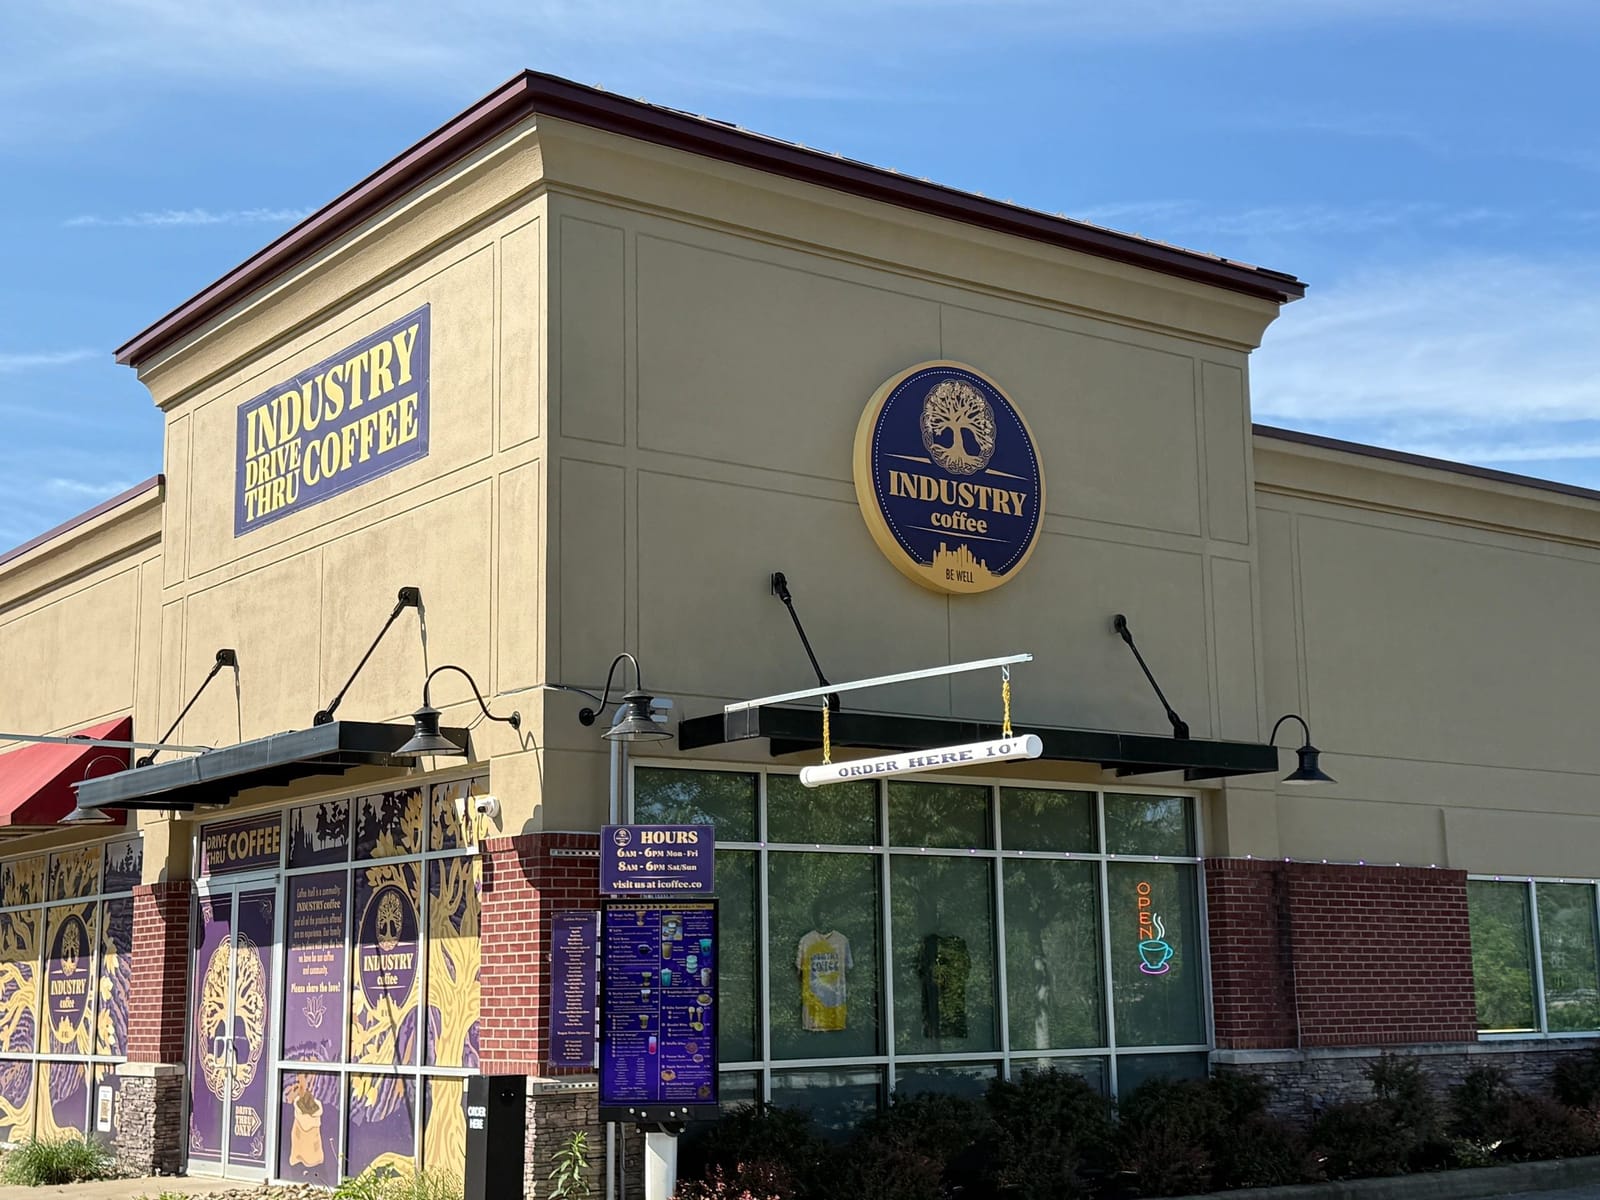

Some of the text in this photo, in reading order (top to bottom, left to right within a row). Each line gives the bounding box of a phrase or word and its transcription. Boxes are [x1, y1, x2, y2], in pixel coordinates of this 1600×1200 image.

[246, 323, 419, 461] INDUSTRY
[302, 392, 418, 486] COFFEE
[245, 437, 302, 491] DRIVE
[244, 468, 300, 522] THRU
[888, 469, 1027, 517] INDUSTRY
[930, 510, 988, 534] coffee
[945, 568, 975, 583] BE WELL
[838, 760, 899, 777] ORDER
[908, 750, 974, 769] HERE
[206, 834, 227, 850] DRIVE
[227, 825, 280, 861] COFFEE
[640, 831, 698, 845] HOURS
[207, 849, 226, 865] THRU
[617, 847, 637, 858] 6AM
[644, 847, 664, 858] 6PM
[617, 861, 638, 872] 8AM
[645, 861, 665, 872] 6PM
[612, 879, 702, 889] visit us at icoffee.co
[296, 898, 341, 912] INDUSTRY coffee
[1136, 881, 1154, 940] OPEN
[363, 953, 414, 972] INDUSTRY
[50, 978, 87, 995] INDUSTRY
[467, 1106, 486, 1117] ORDER
[234, 1124, 251, 1137] ONLY
[469, 1118, 484, 1130] HERE
